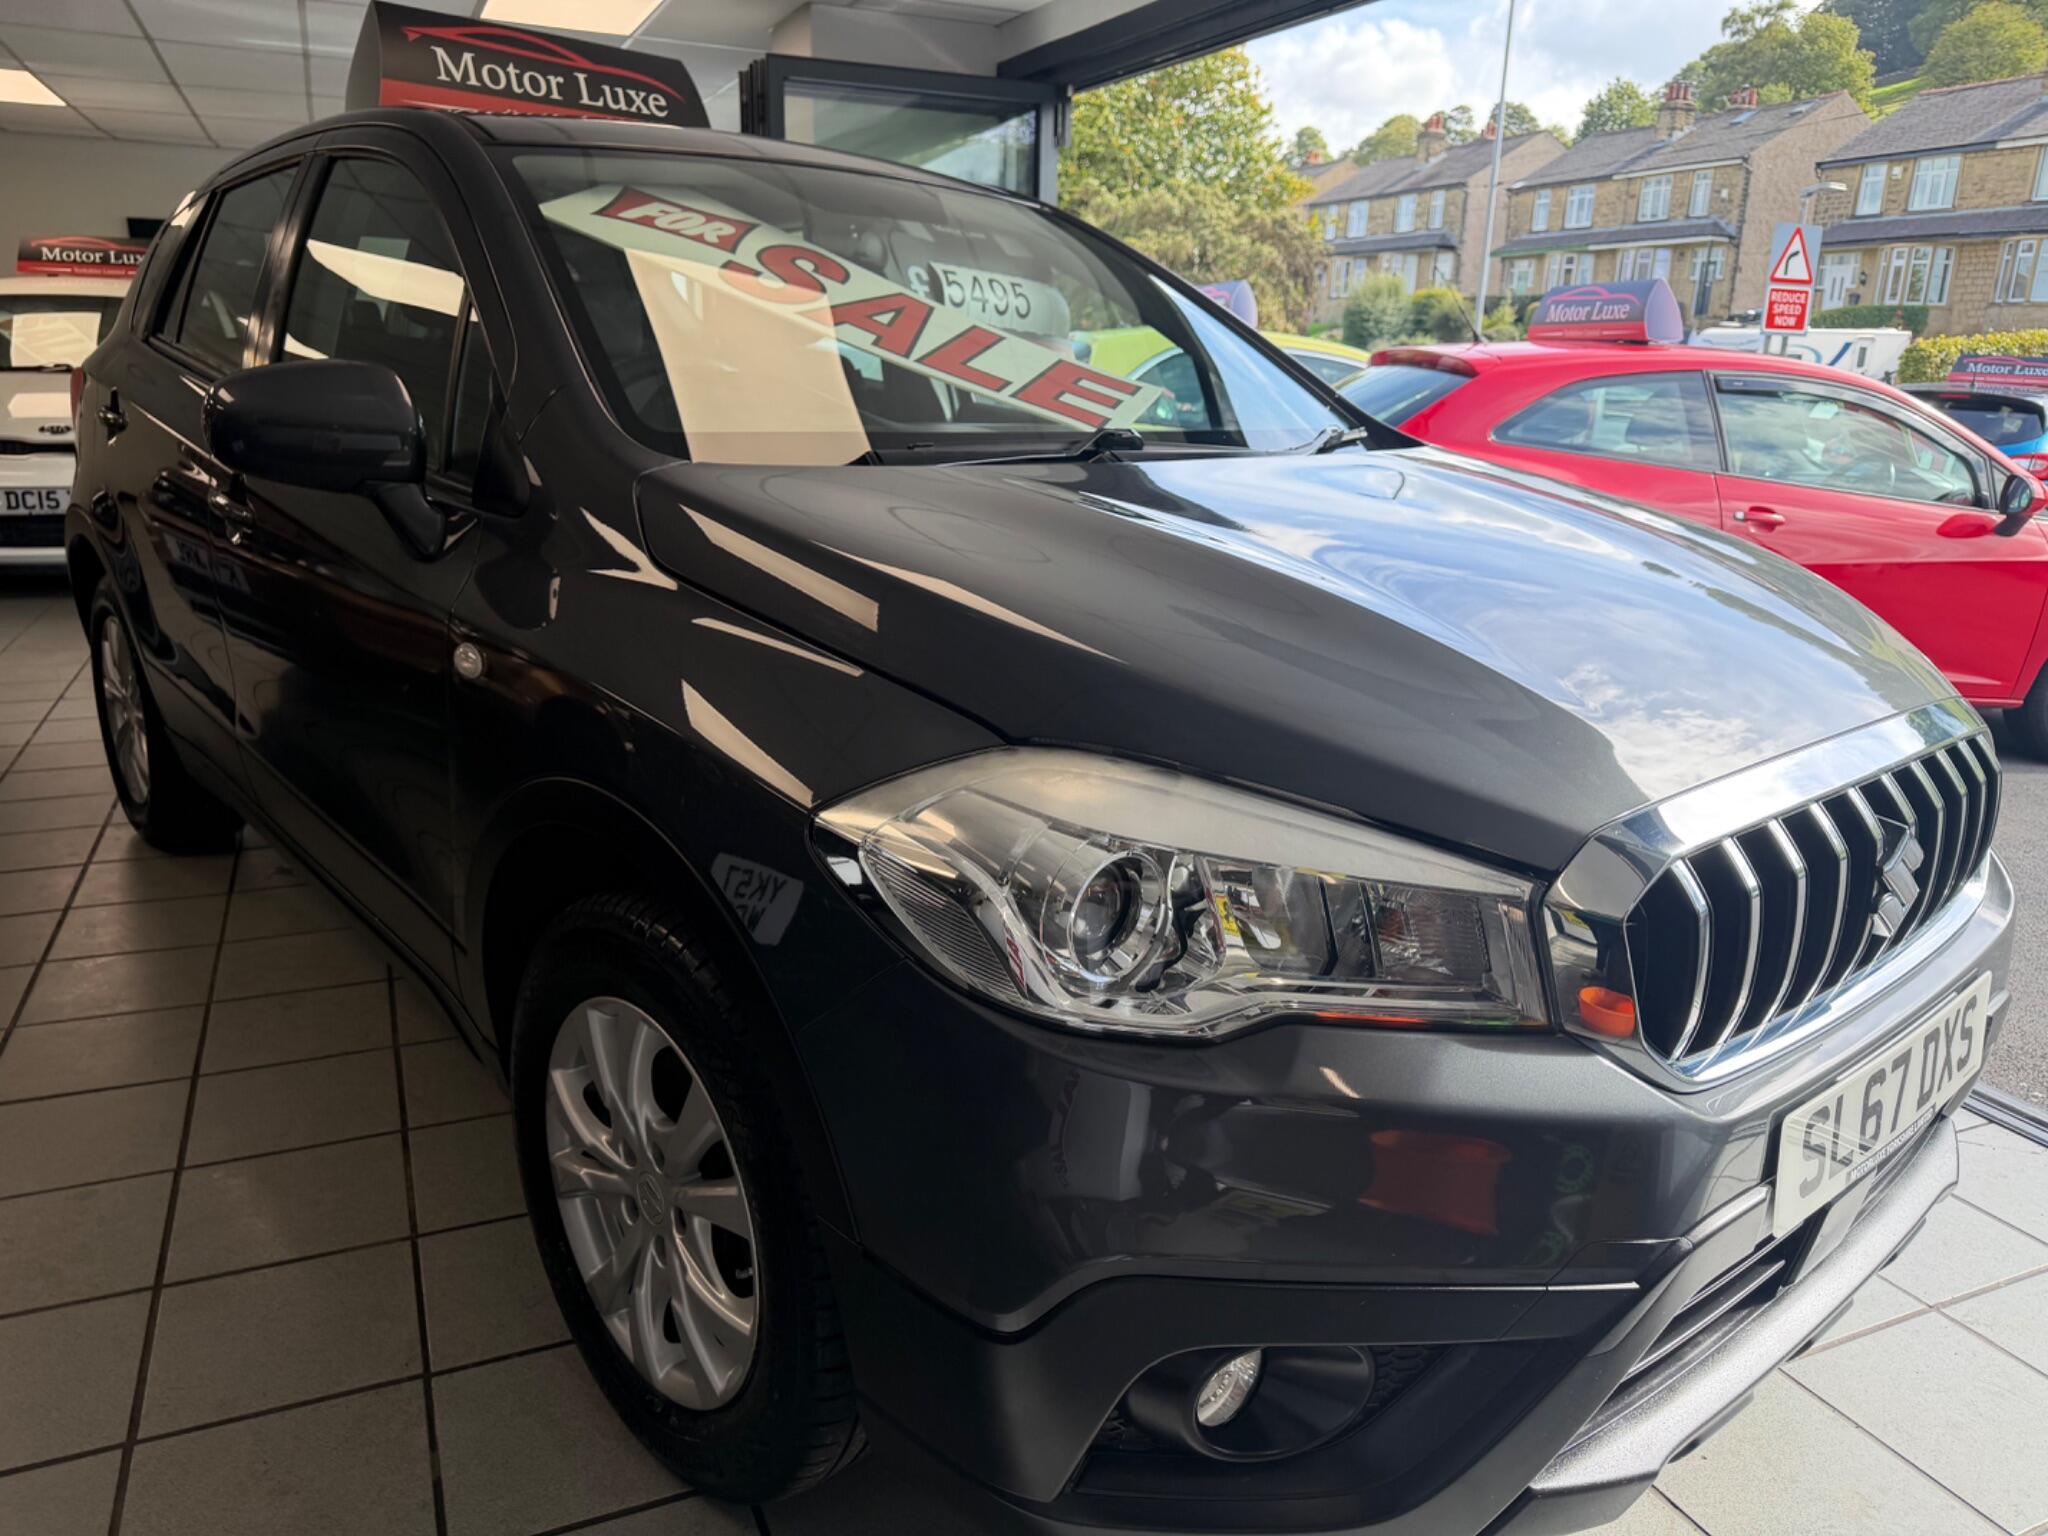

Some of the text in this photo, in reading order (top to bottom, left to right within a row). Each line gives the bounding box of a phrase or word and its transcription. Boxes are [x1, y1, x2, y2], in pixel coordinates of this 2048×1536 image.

[430, 45, 669, 118] Motor Luxe
[41, 246, 146, 265] Motor Lux
[1770, 291, 1807, 304] REDUCE
[617, 202, 1143, 429] FOR SALE
[1545, 301, 1631, 323] Motor Luxe
[1771, 303, 1802, 315] SPEED
[1773, 315, 1797, 327] NOW
[1966, 363, 2013, 374] Motor
[4, 491, 60, 511] DC15
[1799, 1046, 1913, 1199] SL67
[1916, 994, 1978, 1112] DXS
